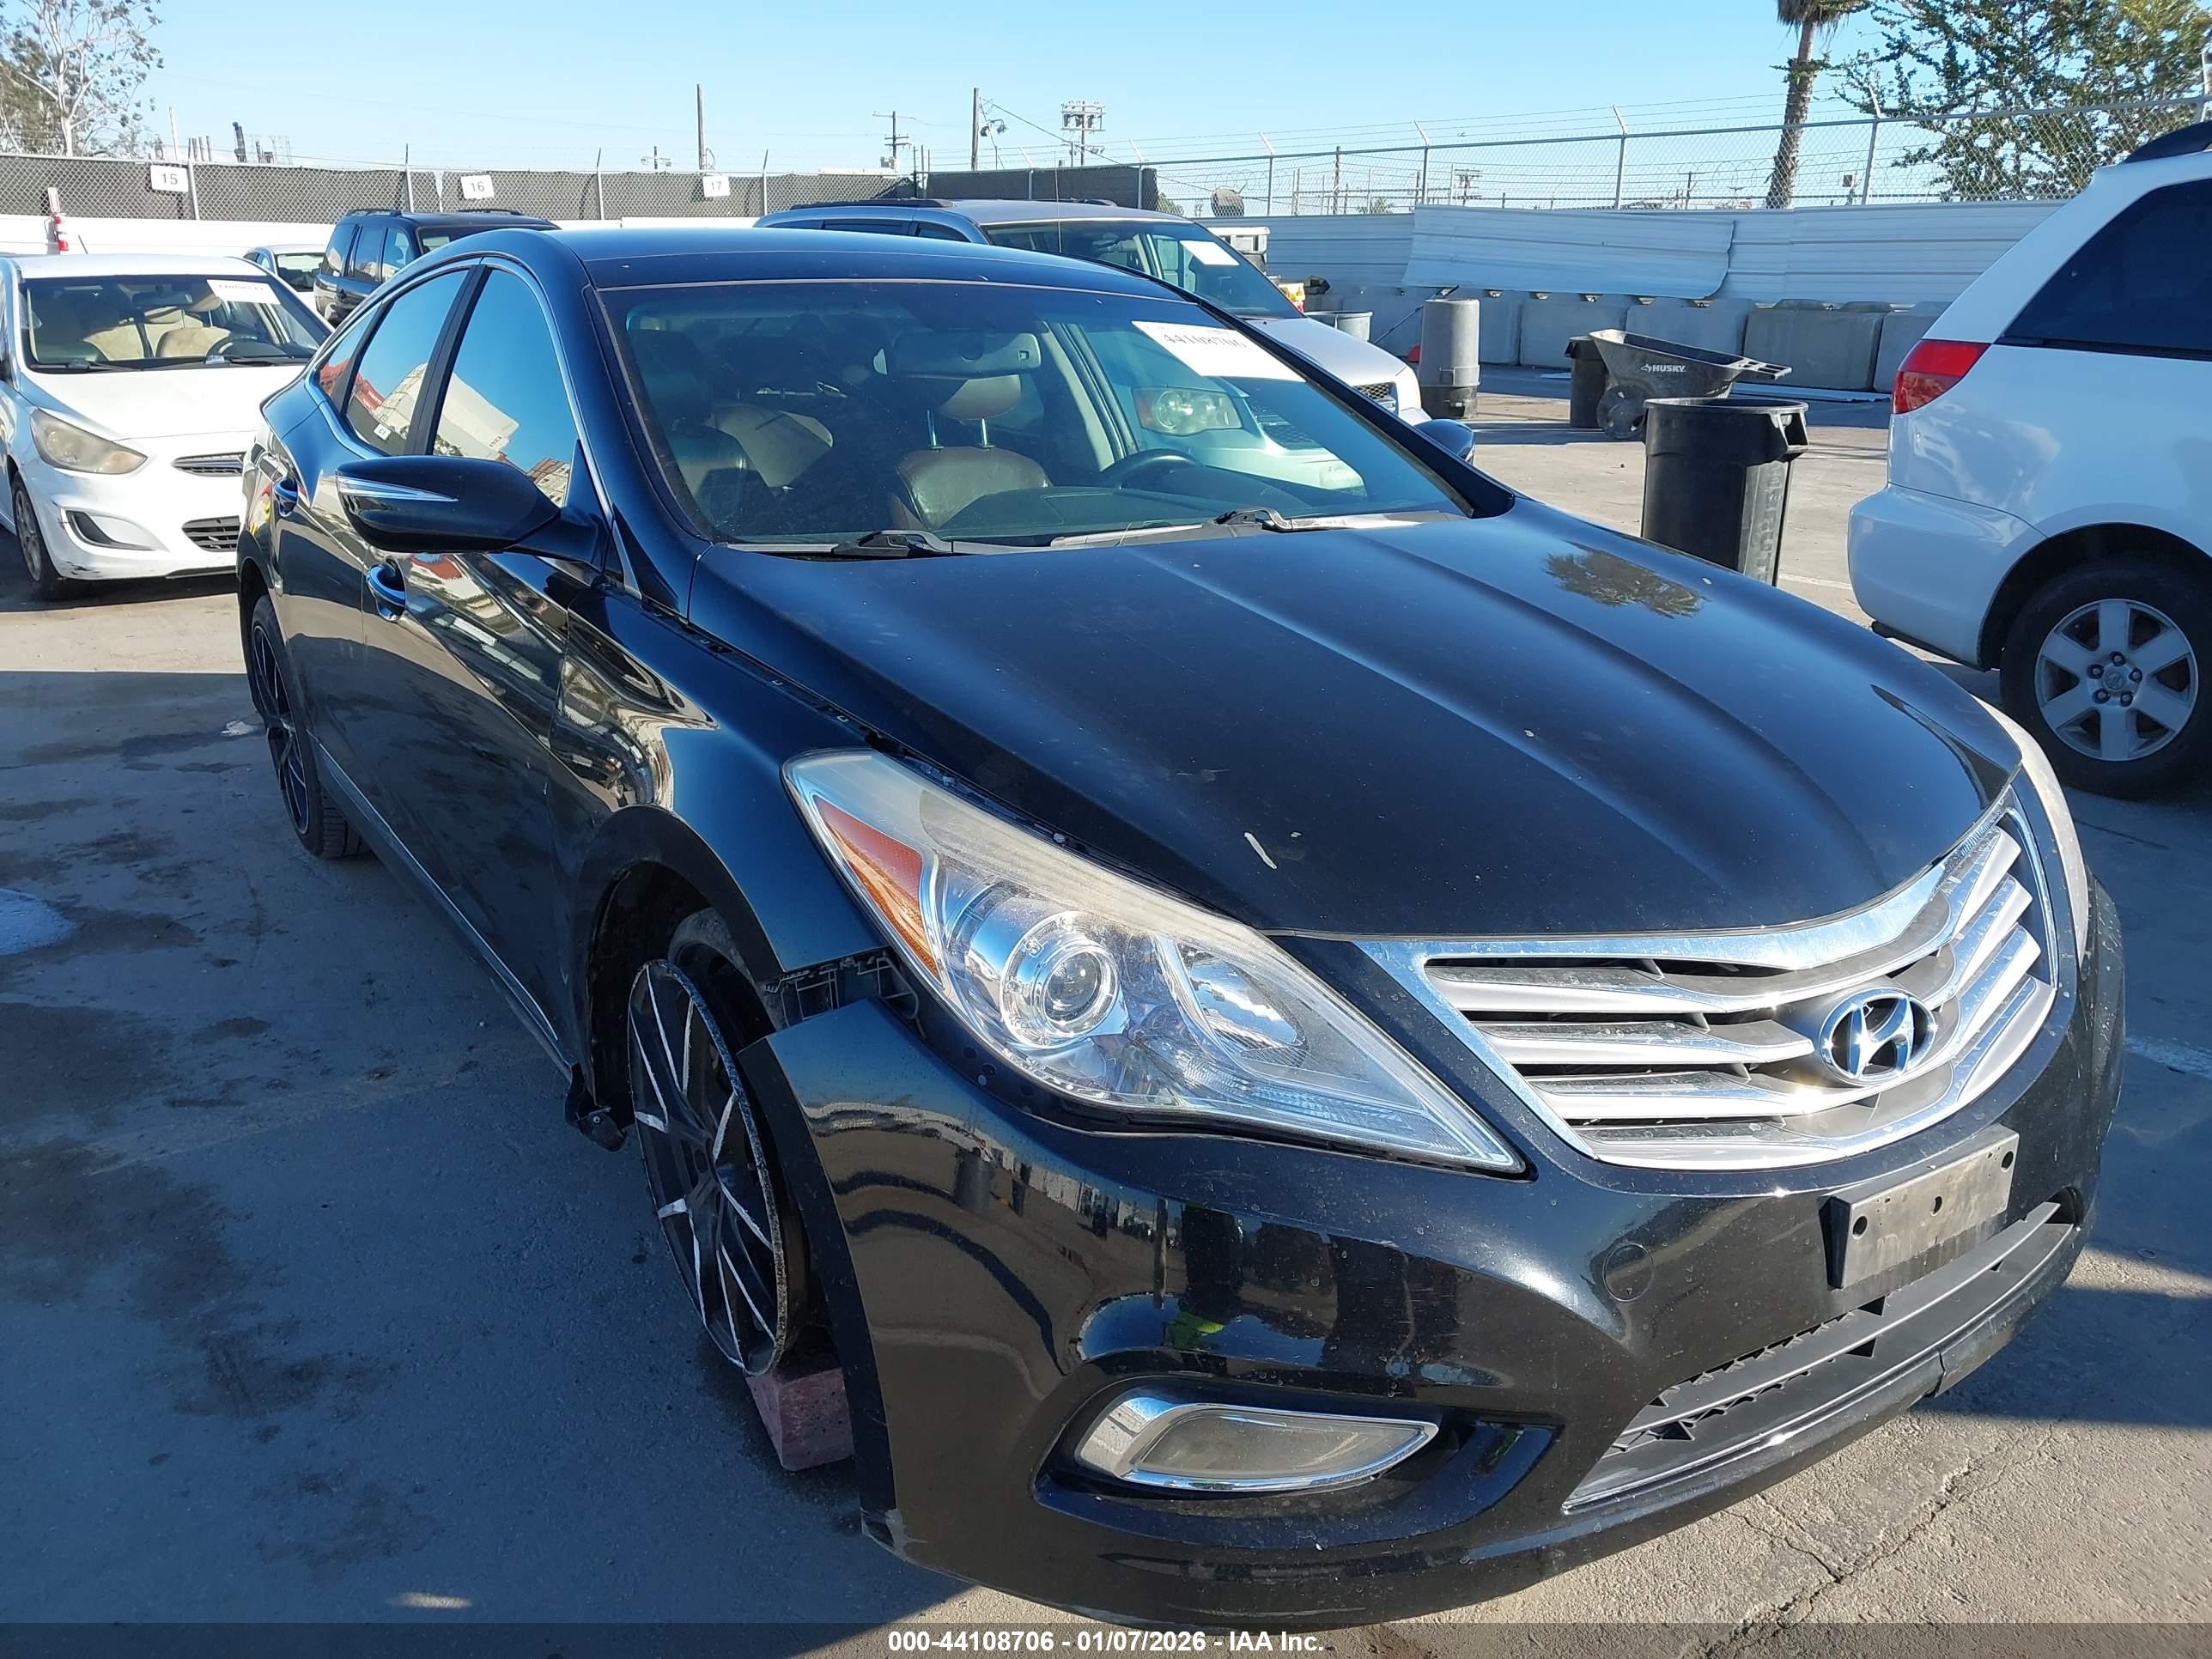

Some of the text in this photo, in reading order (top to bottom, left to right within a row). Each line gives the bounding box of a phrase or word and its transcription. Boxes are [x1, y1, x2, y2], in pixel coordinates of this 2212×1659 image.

[161, 173, 179, 185] 15
[471, 181, 485, 192] 16
[711, 180, 722, 191] 17
[1652, 364, 1686, 373] HUSKY
